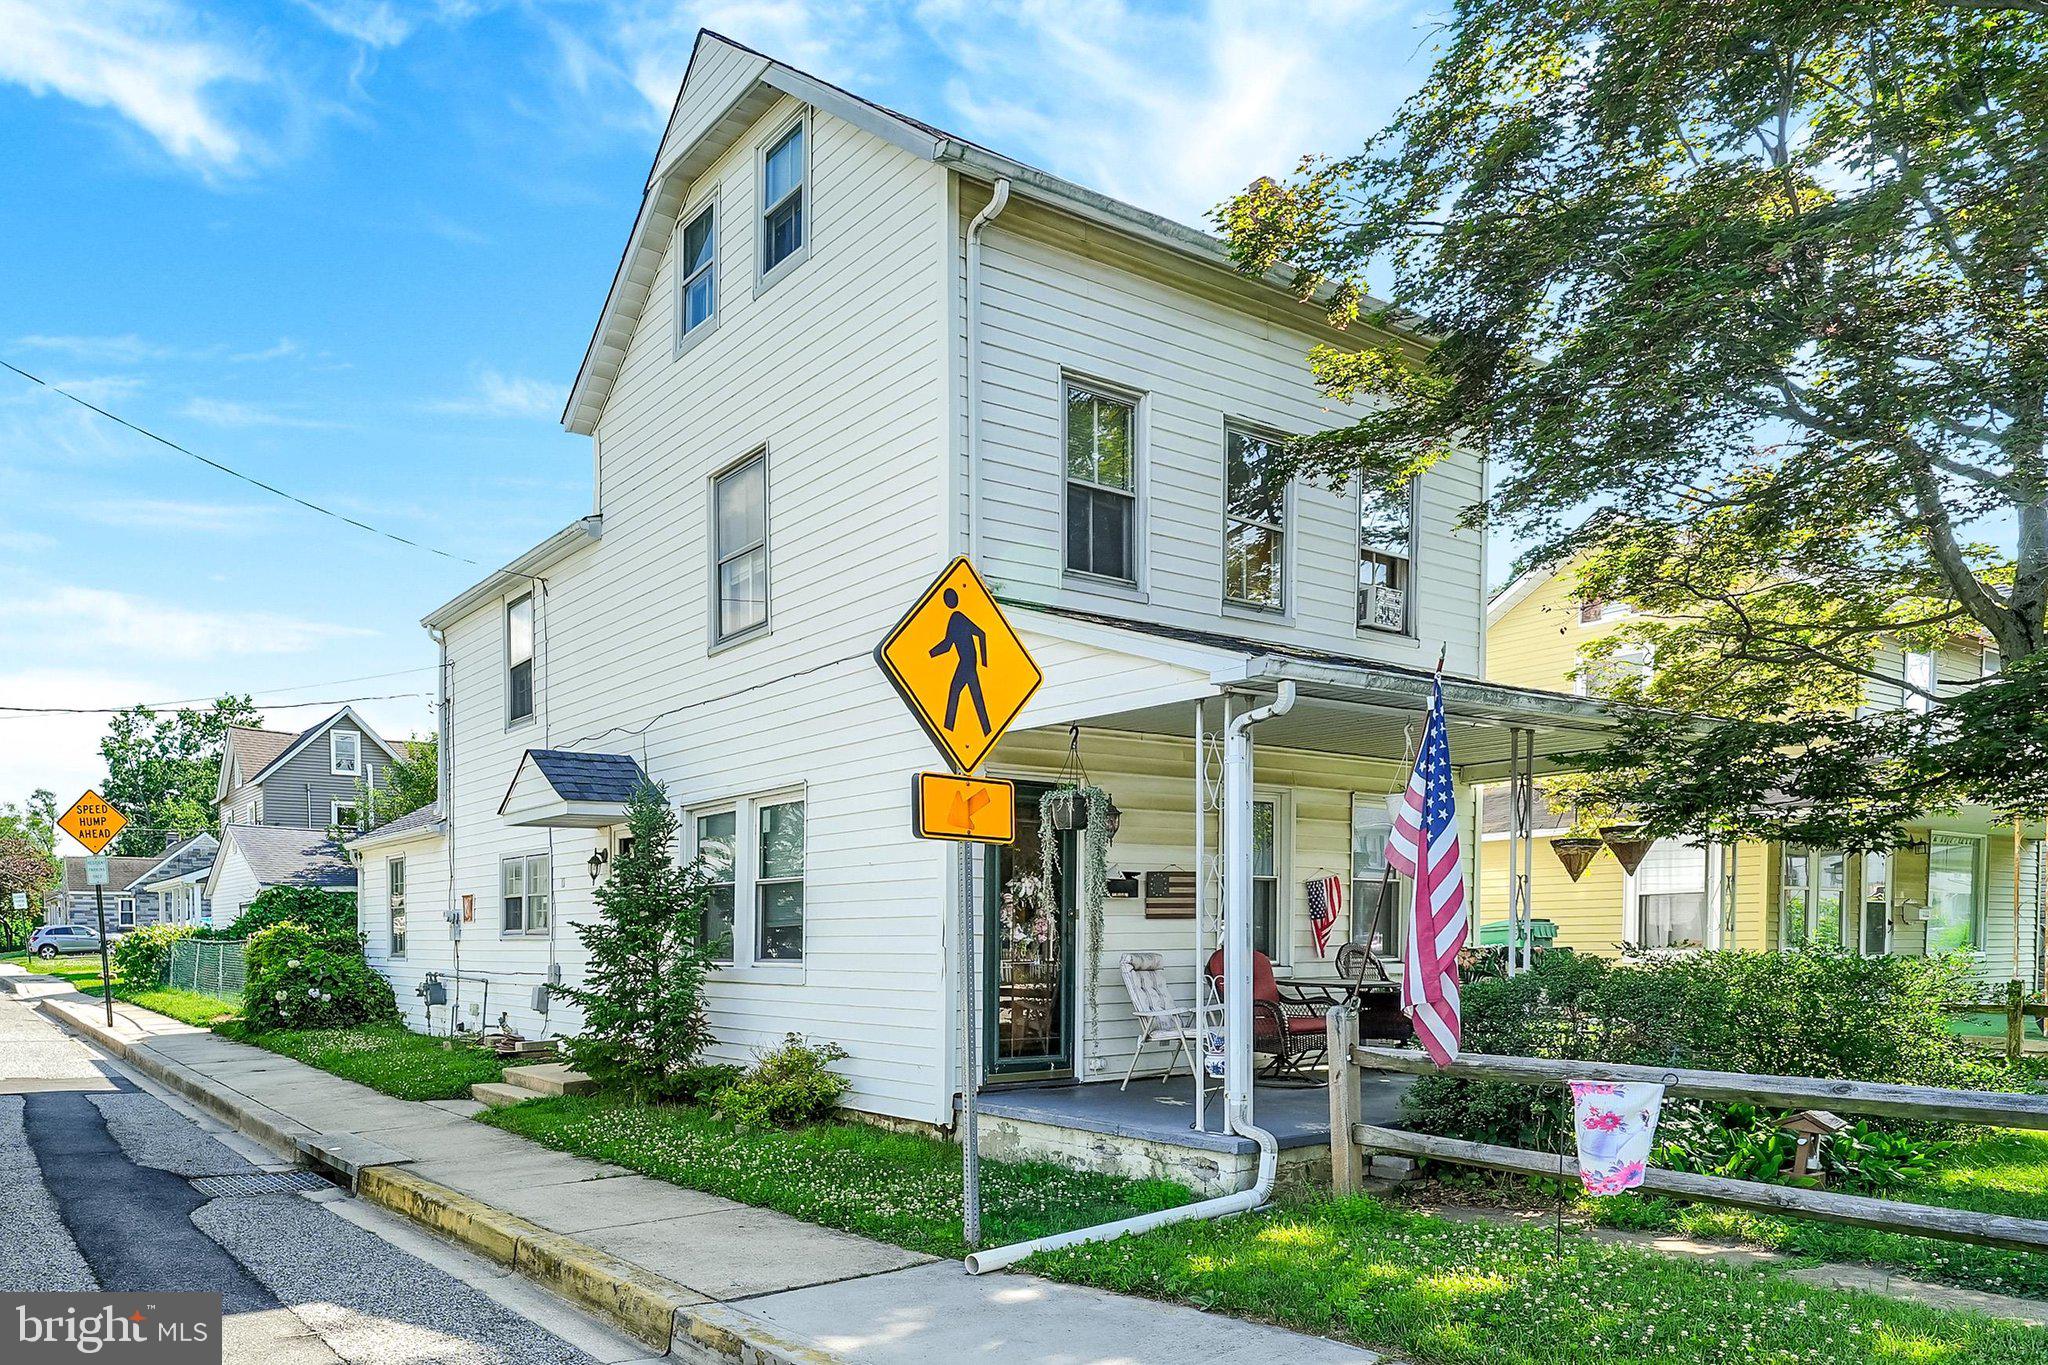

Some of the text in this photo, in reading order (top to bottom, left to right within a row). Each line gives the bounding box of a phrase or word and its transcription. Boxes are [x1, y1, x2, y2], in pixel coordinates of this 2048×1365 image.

[76, 804, 108, 815] SPEED
[79, 816, 107, 827] HUMP
[78, 828, 111, 839] AHEAD
